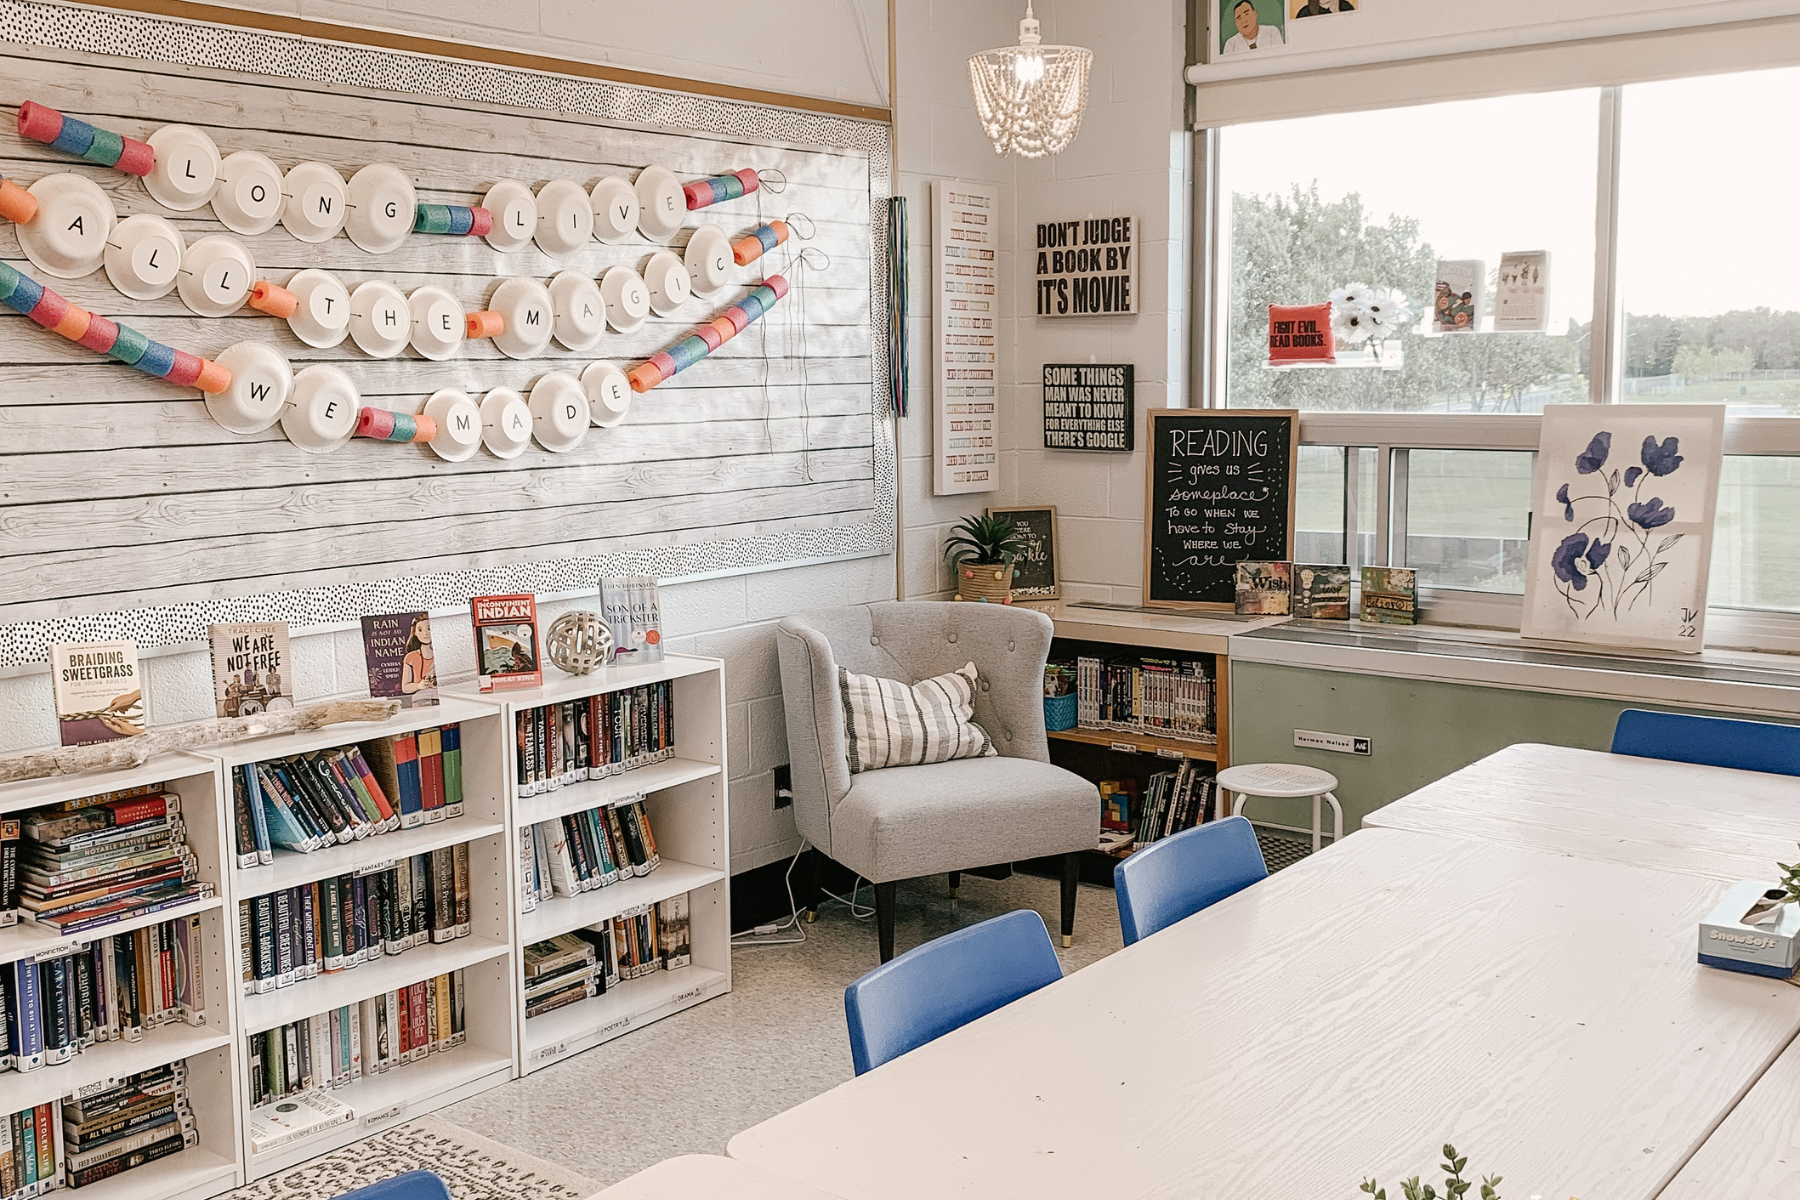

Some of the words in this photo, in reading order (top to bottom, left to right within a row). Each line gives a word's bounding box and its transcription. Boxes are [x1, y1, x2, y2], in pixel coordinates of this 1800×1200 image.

[186, 159, 397, 219] LONG
[516, 196, 674, 229] LIVE
[1037, 221, 1079, 248] DON'T
[1083, 217, 1130, 245] JUDGE
[1036, 252, 1048, 274] A
[1053, 248, 1101, 273] BOOK
[1106, 246, 1130, 270] BY
[68, 215, 230, 290] ALL
[324, 298, 451, 331] THE
[527, 258, 724, 326] MAGIC
[1037, 278, 1068, 314] IT'S
[1073, 276, 1130, 313] MOVIE
[1274, 321, 1294, 332] FIGHT
[1270, 335, 1290, 348] READ
[1293, 334, 1326, 347] BOOKS.
[1045, 368, 1077, 385] SOME
[1079, 368, 1124, 386] THINGS
[1045, 387, 1066, 401] MAN
[1068, 387, 1091, 402] WAS
[1093, 388, 1124, 402] NEVER
[250, 382, 337, 419] WE
[457, 385, 620, 430] MADE
[1046, 403, 1077, 417] MEANT
[1079, 403, 1091, 418] TO
[1094, 404, 1124, 418] KNOW
[1046, 418, 1059, 430] FOR
[1061, 419, 1106, 430] EVERYTHING
[1108, 420, 1124, 431] ELSE
[1046, 431, 1084, 446] THERE'S
[1086, 433, 1124, 448] GOOGLE
[1170, 430, 1267, 456] READING
[1189, 464, 1220, 486] gives
[1226, 466, 1240, 475] us
[1169, 486, 1269, 505] someplace
[1204, 508, 1235, 518] WHEN
[1244, 510, 1260, 518] WE
[1168, 520, 1200, 534] have
[1202, 522, 1215, 534] to
[1184, 540, 1218, 549] WHERE
[1223, 541, 1241, 549] WE
[1172, 554, 1248, 566] are
[1250, 576, 1287, 590] Wish
[478, 600, 530, 608] INCONVENIENT
[607, 604, 629, 614] SON
[633, 602, 647, 613] OF
[651, 602, 658, 611] A
[478, 606, 531, 619] INDIAN
[373, 620, 398, 630] RAIN
[1678, 625, 1696, 637] 22
[232, 635, 250, 653] WE
[253, 634, 274, 654] ARE
[371, 637, 405, 647] INDIAN
[70, 651, 124, 667] BRAIDING
[375, 647, 404, 657] NAME
[227, 653, 252, 672] NOT
[254, 651, 281, 671] FREE
[62, 664, 133, 681] SWEETGRASS
[525, 732, 534, 770] FEARLESS
[260, 778, 283, 808] DOMINION
[271, 776, 284, 791] TERRA
[281, 789, 294, 807] NOVA
[85, 845, 117, 856] NOTABLE
[120, 837, 144, 848] NATIVE
[361, 862, 384, 872] FANTASY
[259, 897, 270, 935] BEAUTIFUL
[278, 894, 290, 933] BEAUTIFUL
[1709, 929, 1776, 949] SnowSoft
[36, 946, 68, 957] NONFICTION
[260, 936, 272, 974] DARKNESS
[280, 933, 292, 973] CREATURES
[54, 962, 63, 996] CARVE
[413, 982, 424, 994] LIKE
[678, 992, 694, 1000] DRAMA
[30, 1023, 35, 1031] AT
[412, 1016, 425, 1028] LIKES
[604, 1022, 622, 1032] POETRY
[58, 1017, 66, 1047] MARK
[414, 1028, 423, 1039] HER
[79, 1081, 101, 1091] SCIENCE
[81, 1086, 101, 1097] FICTION
[151, 1085, 171, 1095] RIVER
[367, 1112, 389, 1123] ROMANCE
[89, 1130, 100, 1139] ALL
[101, 1126, 112, 1135] THE
[113, 1122, 125, 1132] WAY
